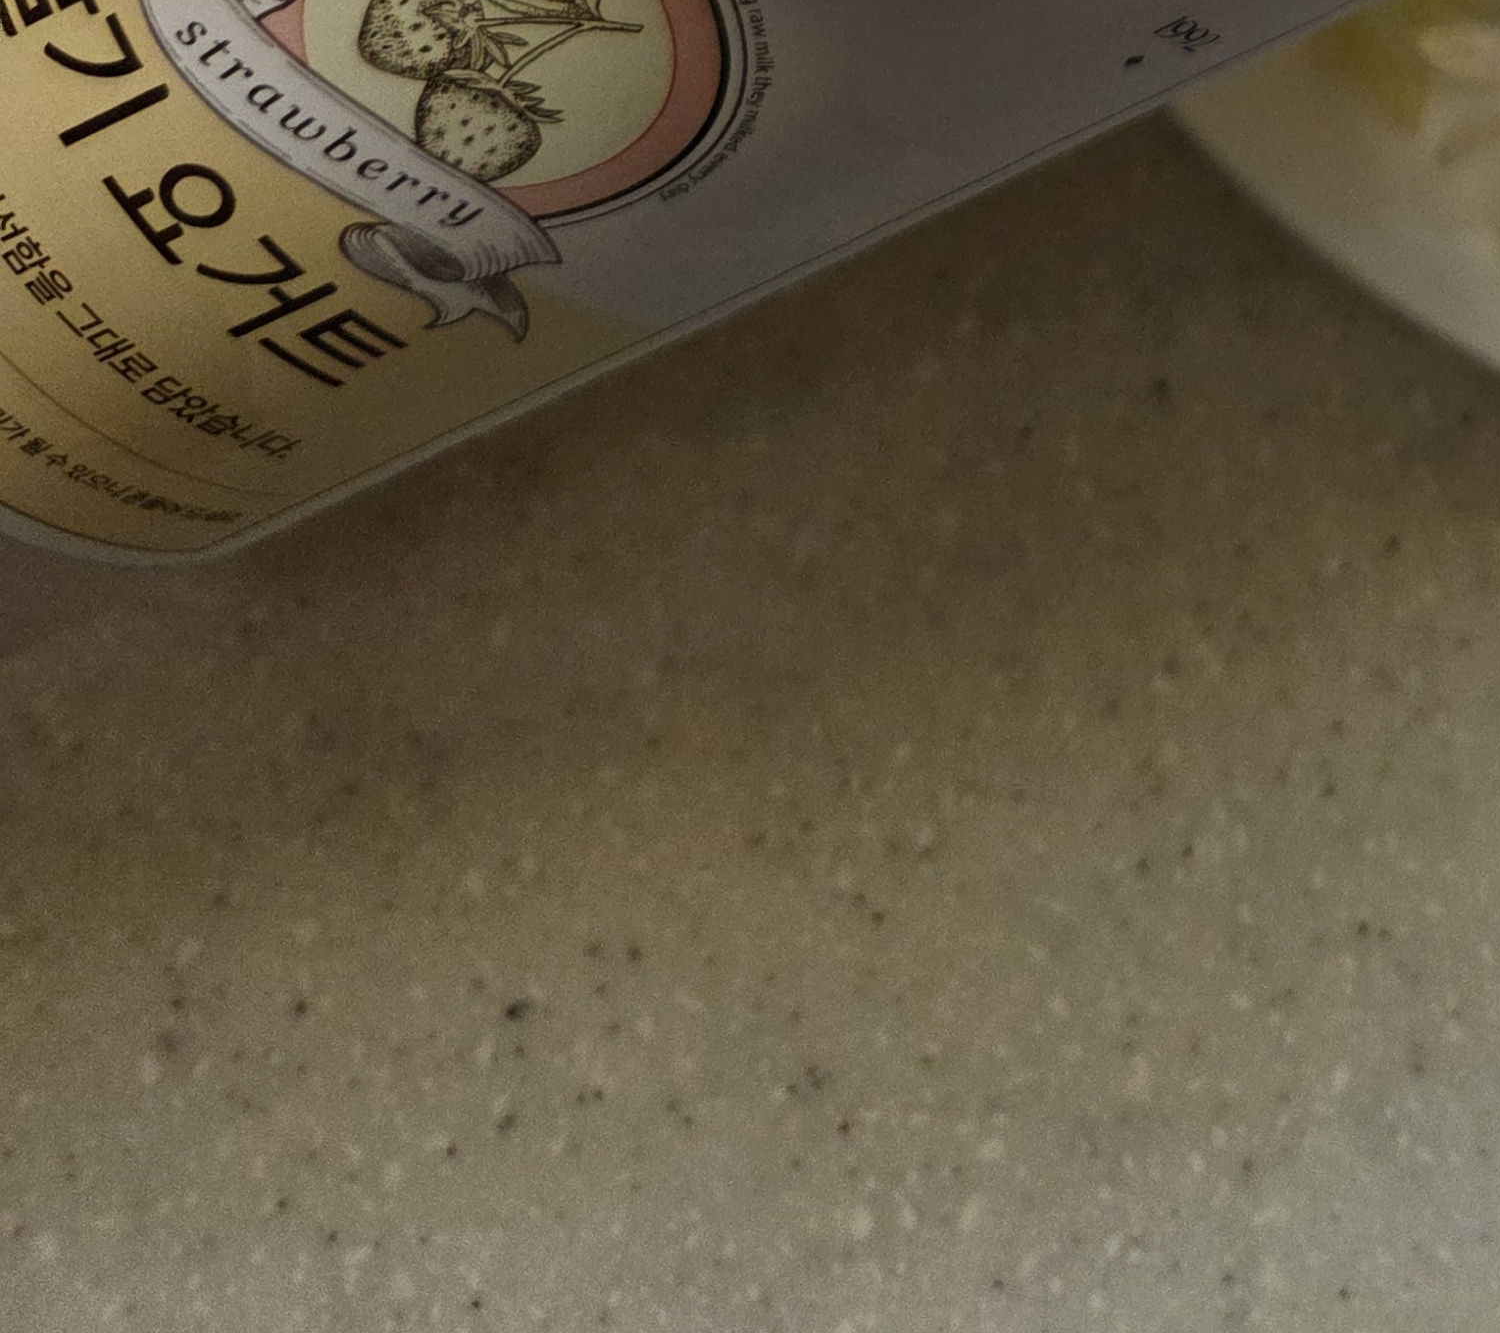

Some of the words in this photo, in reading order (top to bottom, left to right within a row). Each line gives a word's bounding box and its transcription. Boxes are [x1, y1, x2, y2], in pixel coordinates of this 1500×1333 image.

[747, 7, 766, 40] raw
[755, 40, 775, 74] milk
[745, 73, 772, 109] they
[174, 20, 488, 229] strawberry
[103, 163, 407, 387] 요거트
[0, 195, 73, 305] 선함을
[56, 302, 158, 384] 그대로
[140, 376, 302, 460] 담았습니다.
[45, 452, 70, 469] 수
